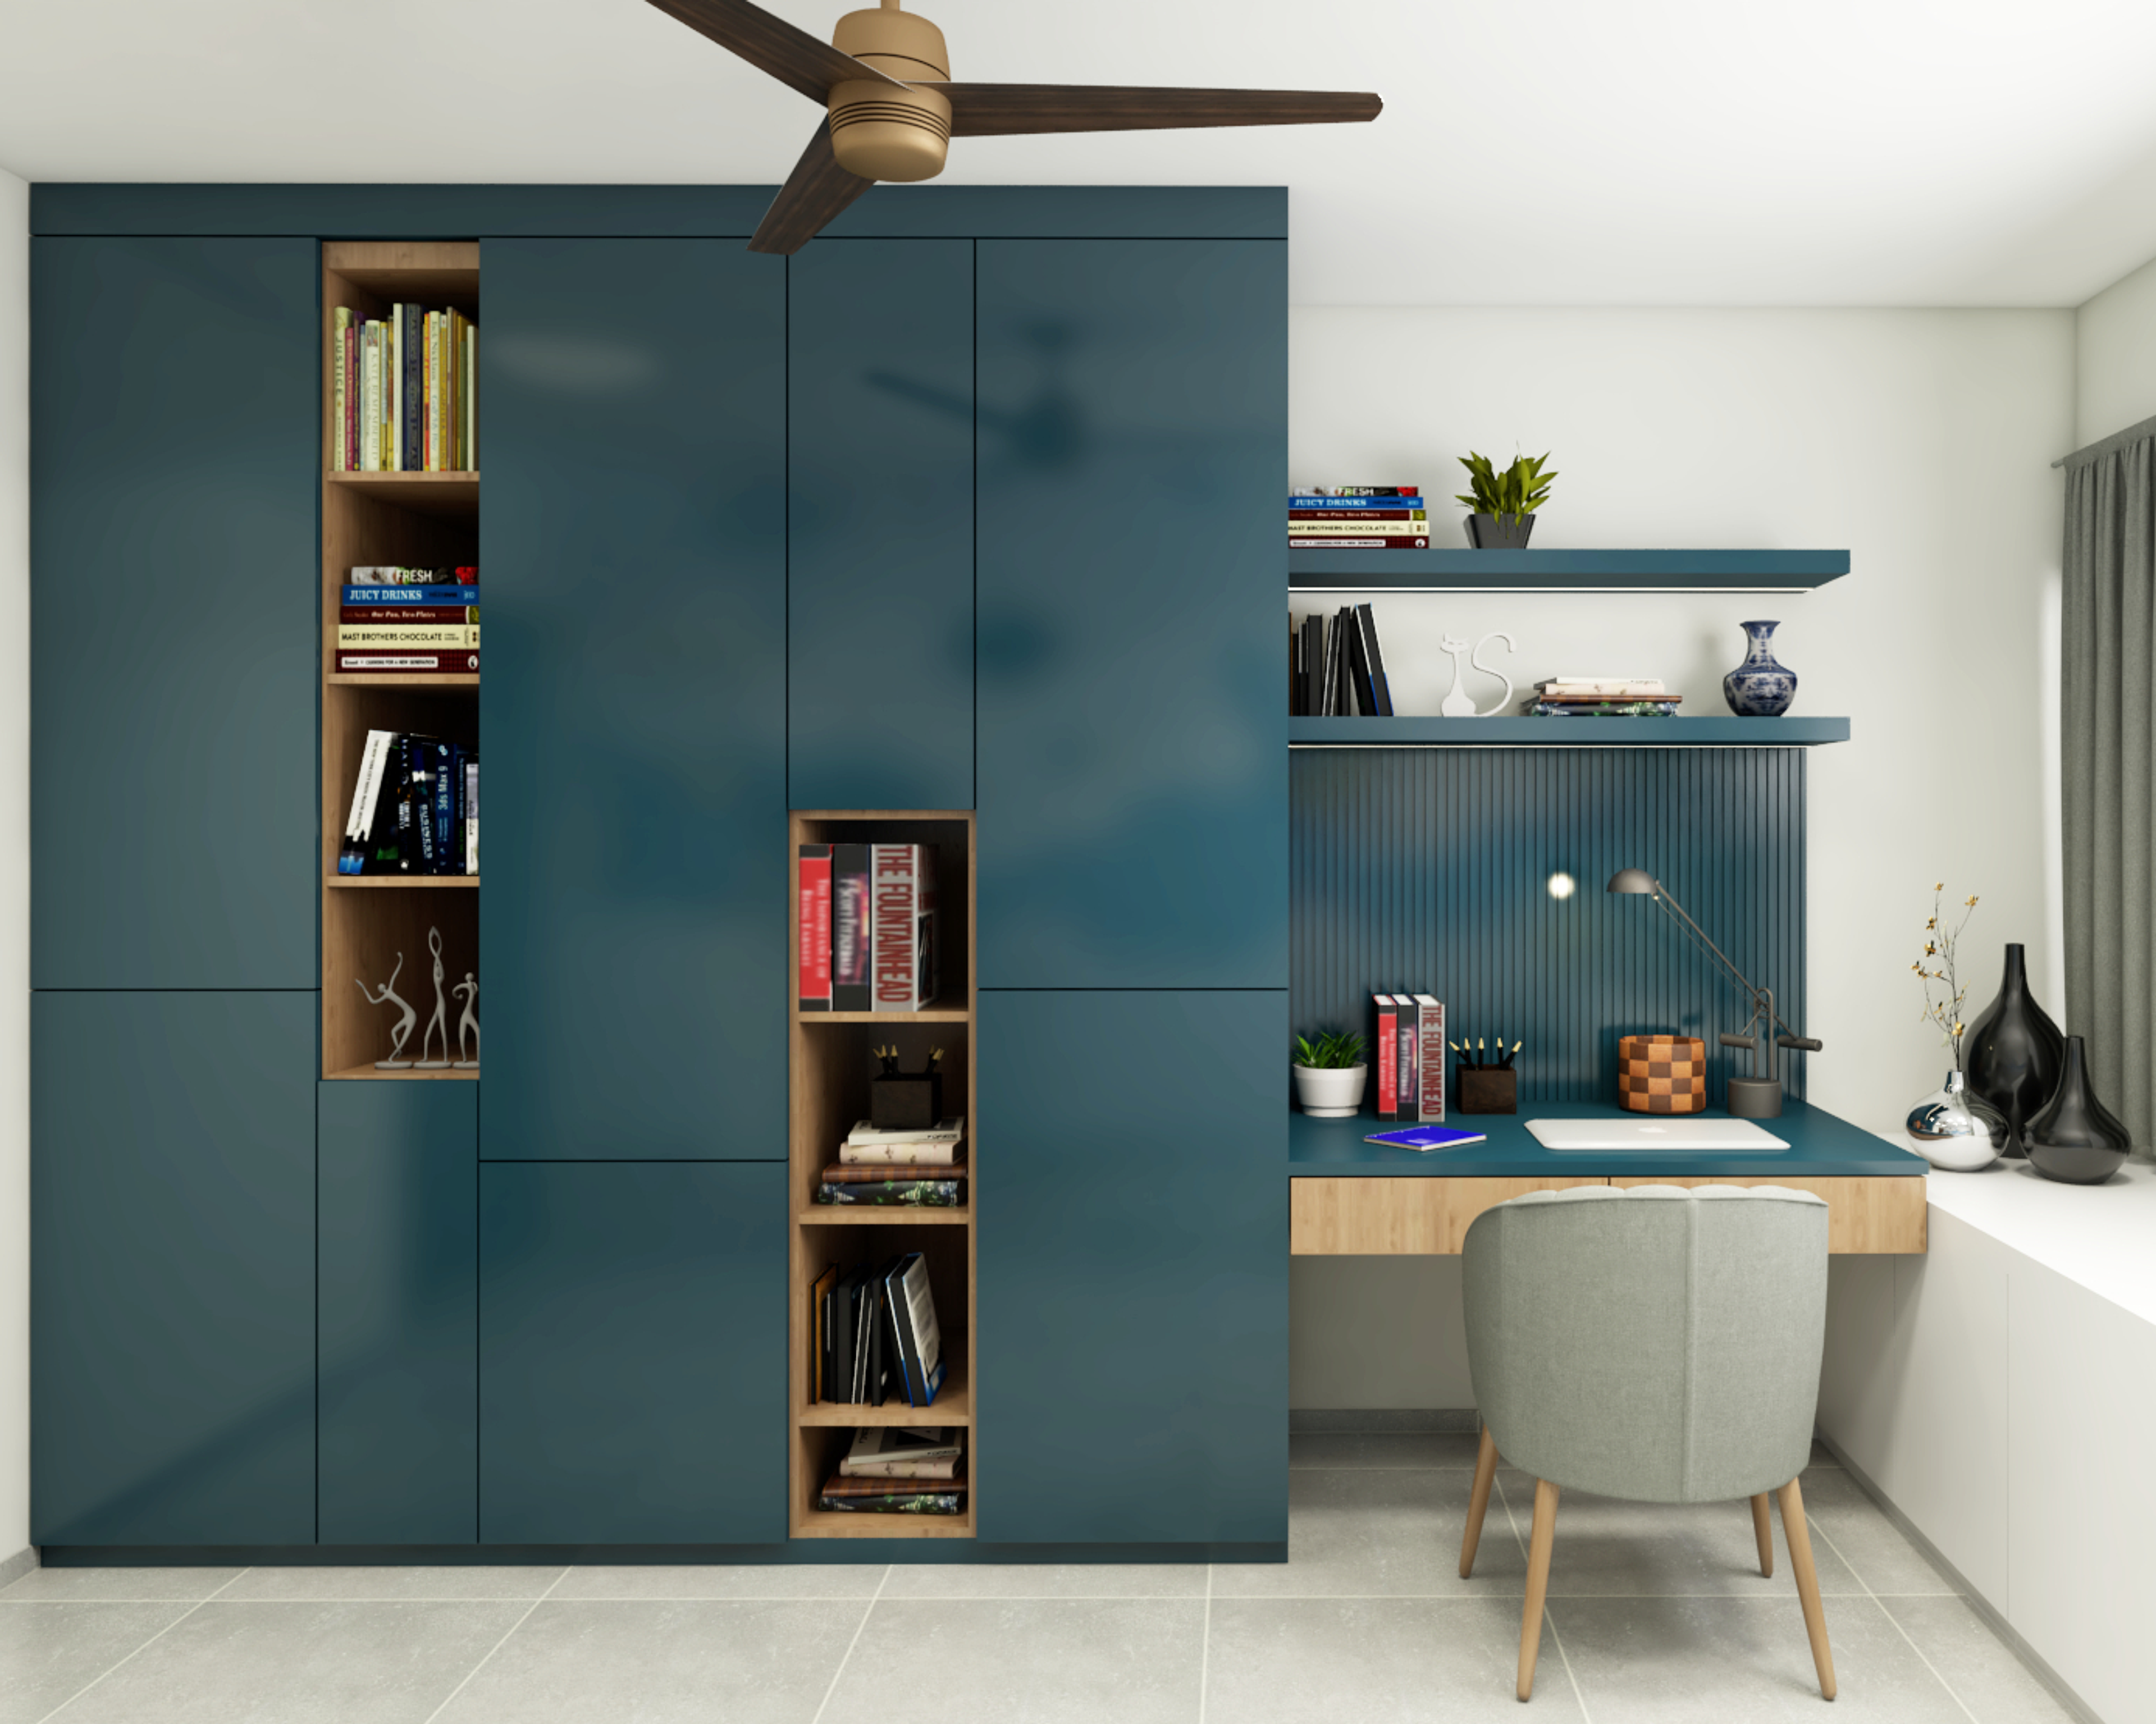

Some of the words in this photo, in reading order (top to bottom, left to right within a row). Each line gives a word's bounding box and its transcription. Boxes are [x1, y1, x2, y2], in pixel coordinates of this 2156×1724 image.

[335, 337, 344, 395] JUSTICE
[1338, 487, 1374, 496] FRESH
[1294, 499, 1324, 507] JUICY
[1326, 499, 1367, 507] DRINKS
[395, 569, 433, 583] FRESH
[349, 589, 380, 601] JUICY
[381, 589, 423, 601] DRINKS
[341, 633, 360, 641] MAST
[362, 633, 398, 641] BROTHERS
[399, 633, 442, 641] CHOCOLATE
[438, 774, 448, 792] Max
[438, 795, 448, 810] 3ds
[877, 845, 913, 877] THE
[877, 883, 913, 1003] FOUNTAINHEAD
[1422, 1005, 1442, 1027] THE
[1422, 1031, 1442, 1115] FOUNTAINHEAD
